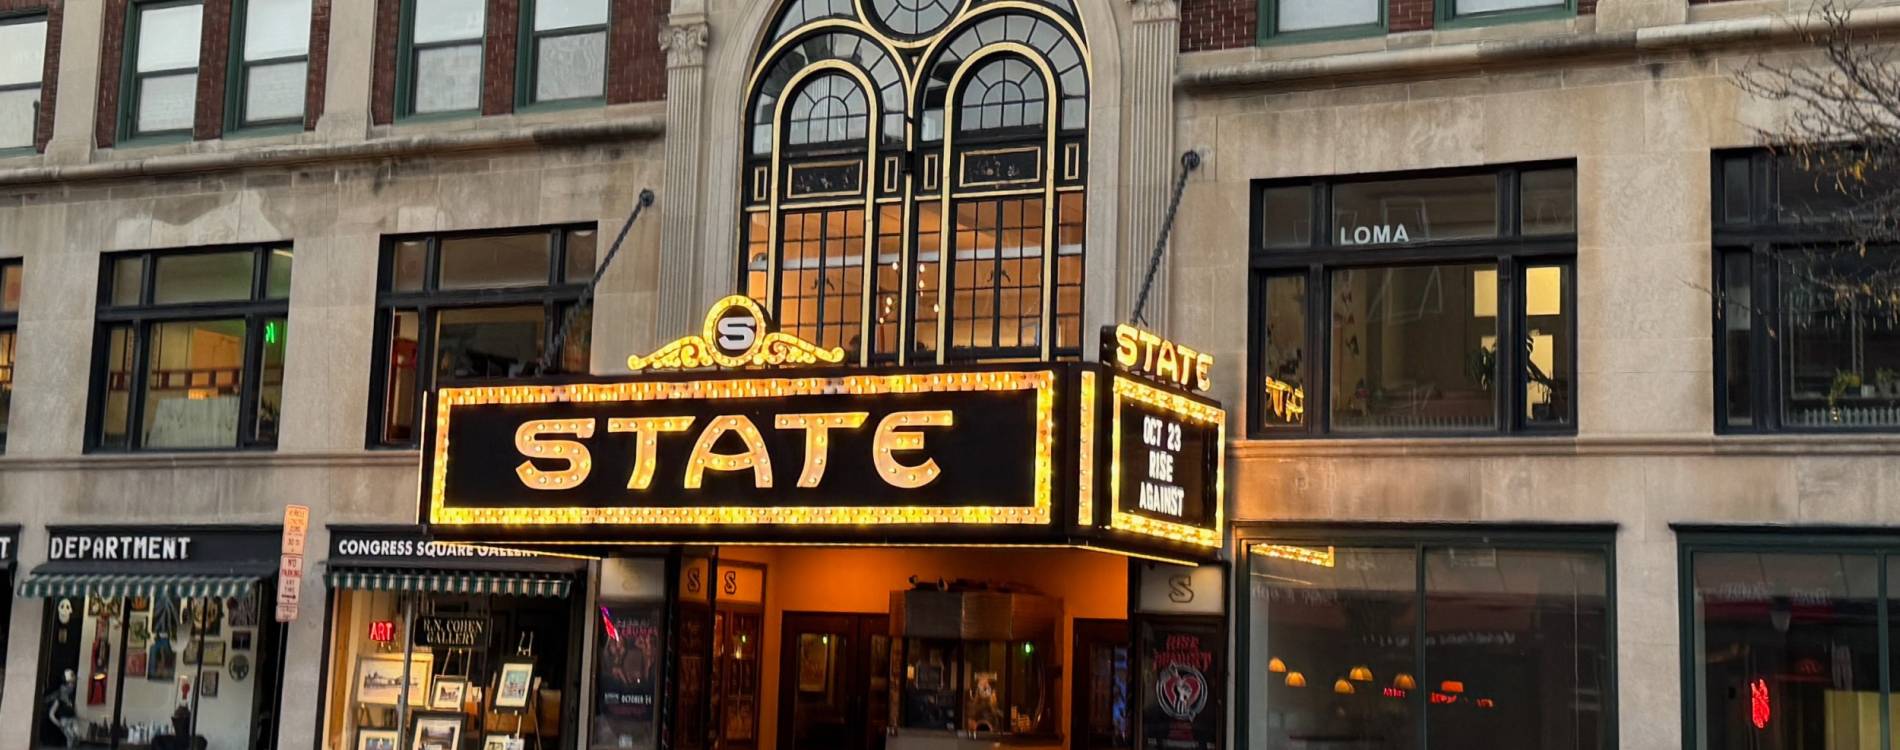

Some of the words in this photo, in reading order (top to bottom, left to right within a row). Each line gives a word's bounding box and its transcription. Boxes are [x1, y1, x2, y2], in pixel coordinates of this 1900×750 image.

[1340, 223, 1410, 246] LOMA
[717, 316, 756, 350] S
[1115, 323, 1214, 392] STATE
[1142, 415, 1163, 447] OCT
[1167, 422, 1182, 452] 23
[514, 410, 954, 491] STATE
[1148, 450, 1174, 483] RISE
[1138, 481, 1185, 517] AGAINST
[50, 536, 191, 560] DEPARTMENT
[338, 540, 412, 556] CONGRESS
[416, 541, 475, 558] SQUARE
[724, 570, 737, 595] S
[1168, 574, 1194, 603] S
[370, 621, 393, 641] ART
[426, 631, 475, 645] GALLERY
